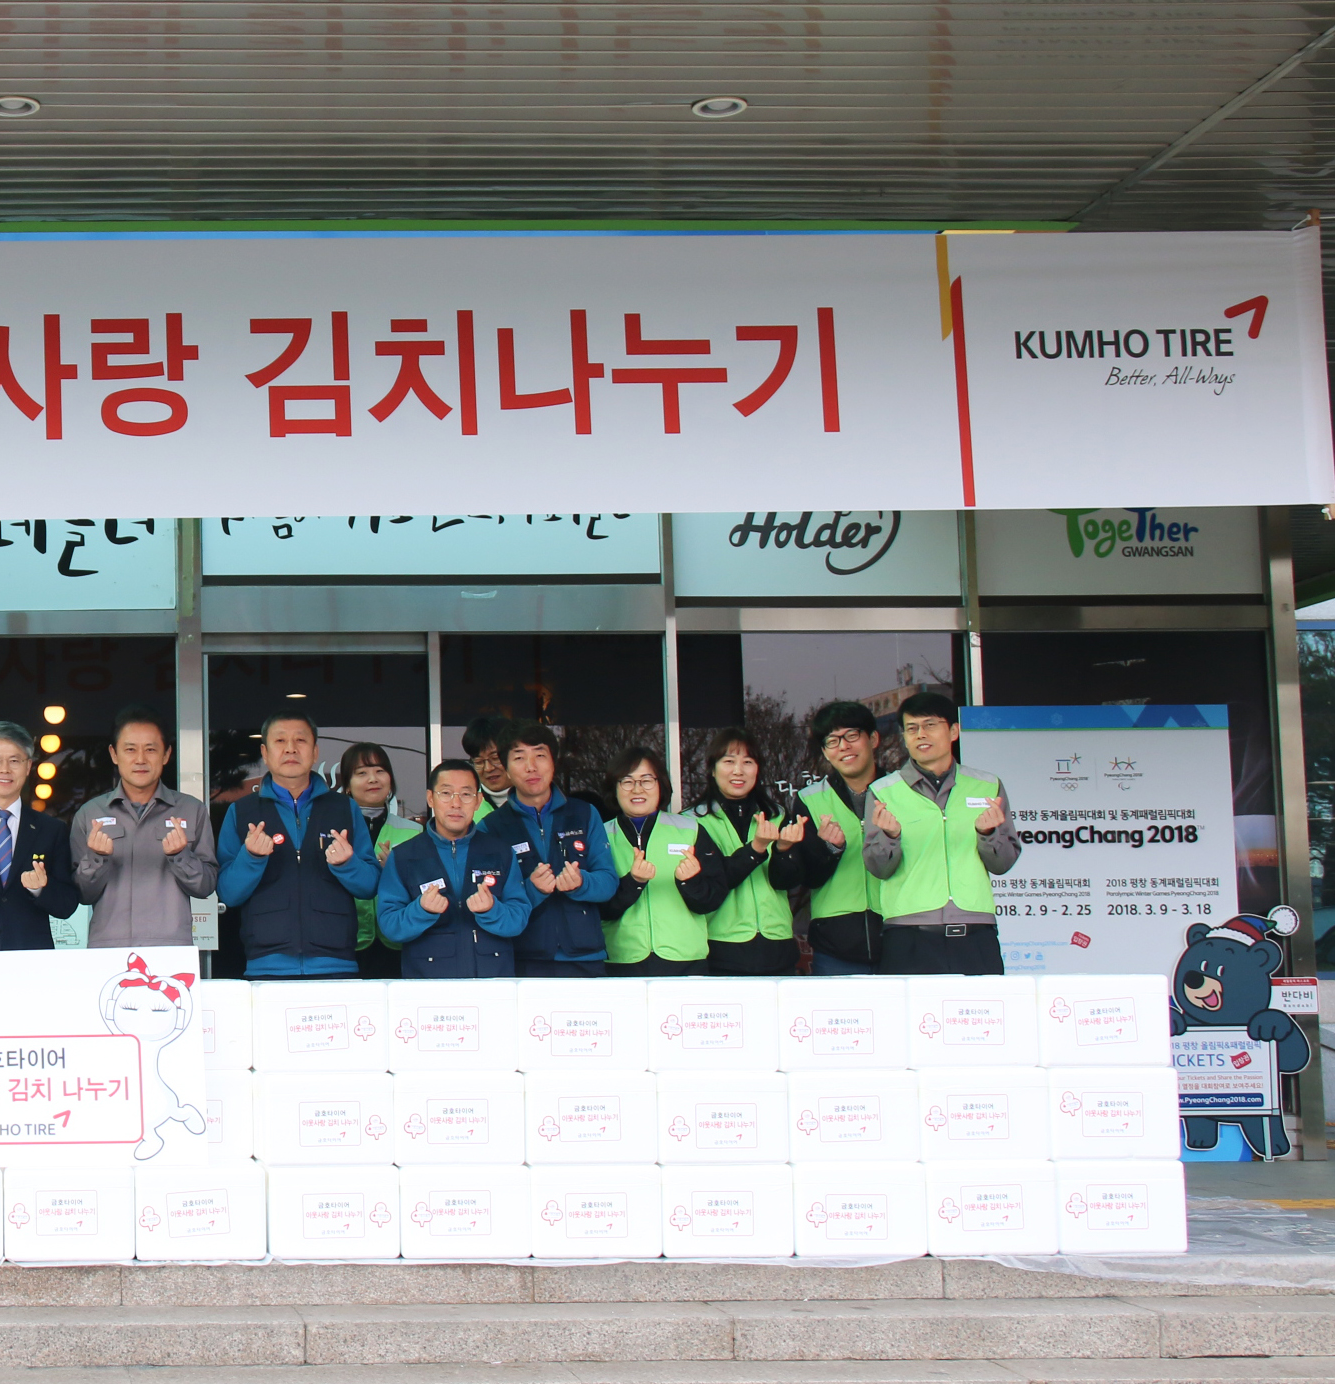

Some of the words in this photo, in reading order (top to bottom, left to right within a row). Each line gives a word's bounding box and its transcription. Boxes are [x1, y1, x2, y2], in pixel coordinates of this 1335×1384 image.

[1014, 329, 1149, 359] KUMHO
[1156, 328, 1234, 358] TIRE
[245, 307, 841, 439] 김치나누기
[1105, 366, 1157, 387] Better,
[1162, 365, 1236, 396] All-Ways
[1122, 545, 1194, 557] GWANGSAN
[1019, 810, 1037, 821] 평창
[1040, 810, 1105, 821] 동계올림픽대회
[1108, 810, 1117, 820] 및
[1120, 809, 1195, 820] 동계패럴림픽대회
[1017, 826, 1143, 849] eongChang
[1147, 825, 1198, 844] 2018
[992, 879, 1007, 888] 018
[1010, 878, 1026, 889] 평창
[1030, 878, 1091, 889] 동계올림픽대회
[1106, 878, 1127, 888] 2018
[1130, 877, 1147, 888] 평창
[1150, 877, 1219, 888] 동계패럴림픽대회
[995, 904, 1021, 917] 018.
[1025, 904, 1036, 916] 2.
[1040, 904, 1048, 916] 9
[1061, 904, 1072, 916] 2.
[1076, 904, 1092, 916] 25
[1107, 904, 1142, 916] 2018.
[1145, 903, 1156, 915] 3.
[1160, 903, 1168, 915] 9
[1182, 903, 1193, 915] 3.
[1197, 902, 1212, 915] 18
[1281, 990, 1313, 1002] 반다비
[697, 1011, 728, 1019] 금호타이어
[958, 1008, 990, 1016] 금호타이어
[1089, 1007, 1121, 1016] 금호타이어
[301, 1014, 333, 1023] 금호타이어
[566, 1019, 598, 1027] 금호타이어
[828, 1017, 859, 1025] 금호타이어
[1103, 1016, 1115, 1025] 김치
[1116, 1015, 1134, 1024] 나누기
[446, 1024, 457, 1032] 김치
[459, 1024, 477, 1032] 나누기
[1182, 1042, 1198, 1050] 평창
[1201, 1041, 1262, 1050] 올림픽&패럴림픽
[1172, 1054, 1225, 1067] ICKETS
[8, 1077, 52, 1102] 김치
[62, 1075, 130, 1102] 나누기
[1179, 1096, 1262, 1104] w.PyeongChang2018.com
[574, 1104, 605, 1112] 금호타이어
[835, 1104, 866, 1113] 금호타이어
[963, 1102, 994, 1110] 금호타이어
[315, 1109, 346, 1117] 금호타이어
[976, 1112, 988, 1120] 김치
[989, 1111, 1007, 1119] 나누기
[24, 1122, 56, 1136] TIRE
[977, 1193, 1008, 1202] 금호타이어
[1102, 1192, 1133, 1200] 금호타이어
[182, 1198, 214, 1207] 금호타이어
[318, 1201, 349, 1209] 금호타이어
[445, 1198, 476, 1206] 금호타이어
[581, 1201, 612, 1209] 금호타이어
[841, 1202, 873, 1210] 금호타이어
